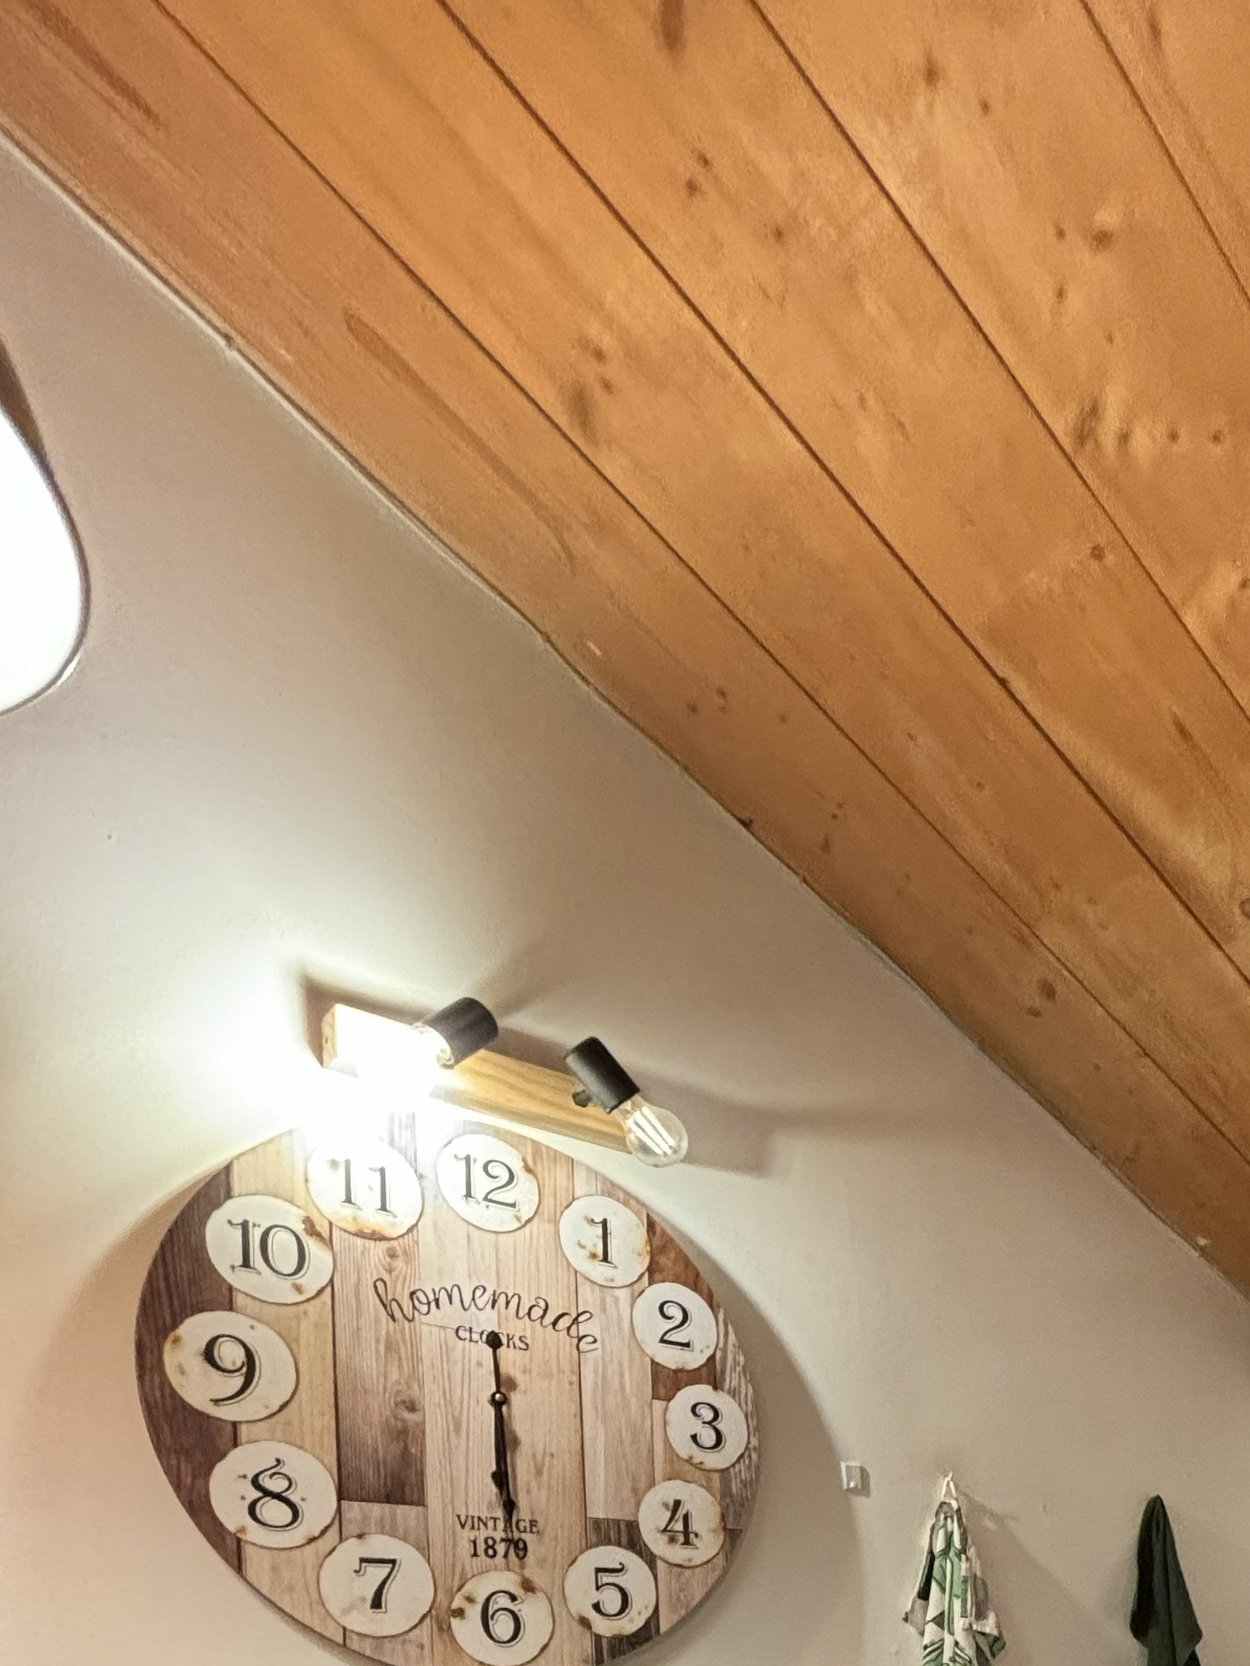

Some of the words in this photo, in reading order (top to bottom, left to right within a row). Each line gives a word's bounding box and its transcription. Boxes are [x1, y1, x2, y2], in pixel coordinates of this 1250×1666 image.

[337, 1158, 398, 1218] 11
[453, 1153, 520, 1213] 12
[227, 1218, 311, 1281] 10
[590, 1217, 618, 1269] 1
[372, 1277, 599, 1354] homemade
[658, 1299, 695, 1352] 2
[201, 1333, 262, 1406] 9
[689, 1401, 727, 1453] 3
[247, 1457, 304, 1532] 8
[661, 1498, 700, 1550] 4
[353, 1557, 402, 1614] 7
[591, 1561, 633, 1621] 5
[480, 1589, 526, 1648] 6
